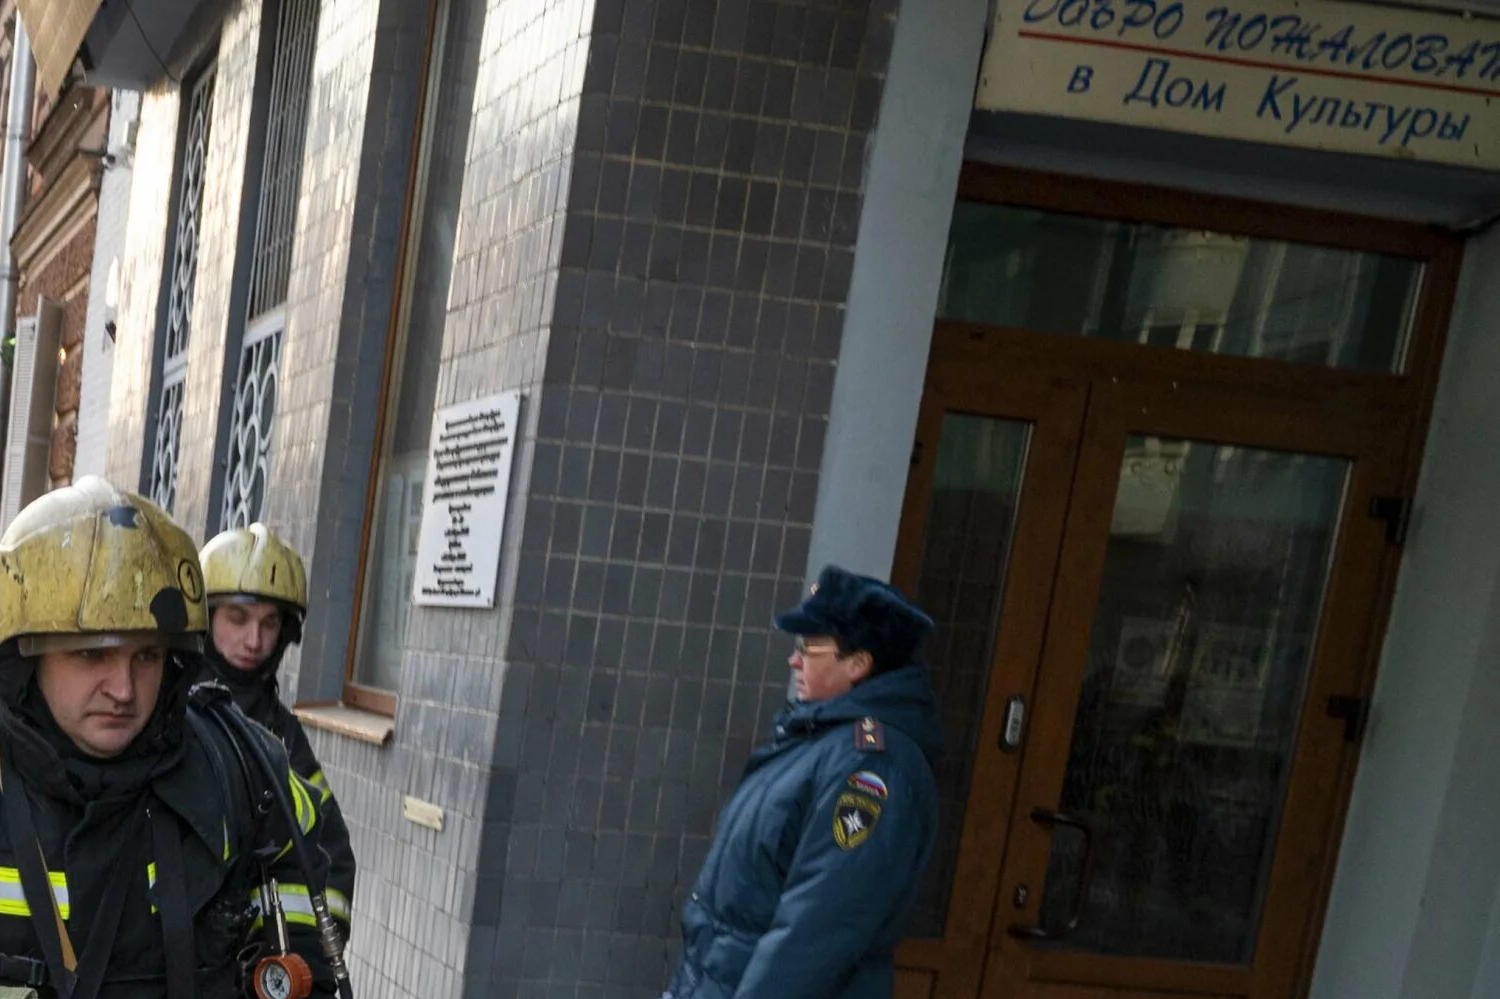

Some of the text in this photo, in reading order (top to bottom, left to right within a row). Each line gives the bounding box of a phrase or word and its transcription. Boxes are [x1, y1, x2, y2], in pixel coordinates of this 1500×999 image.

[1122, 56, 1227, 113] Дом
[1255, 74, 1470, 146] Культуры
[186, 566, 197, 595] 1
